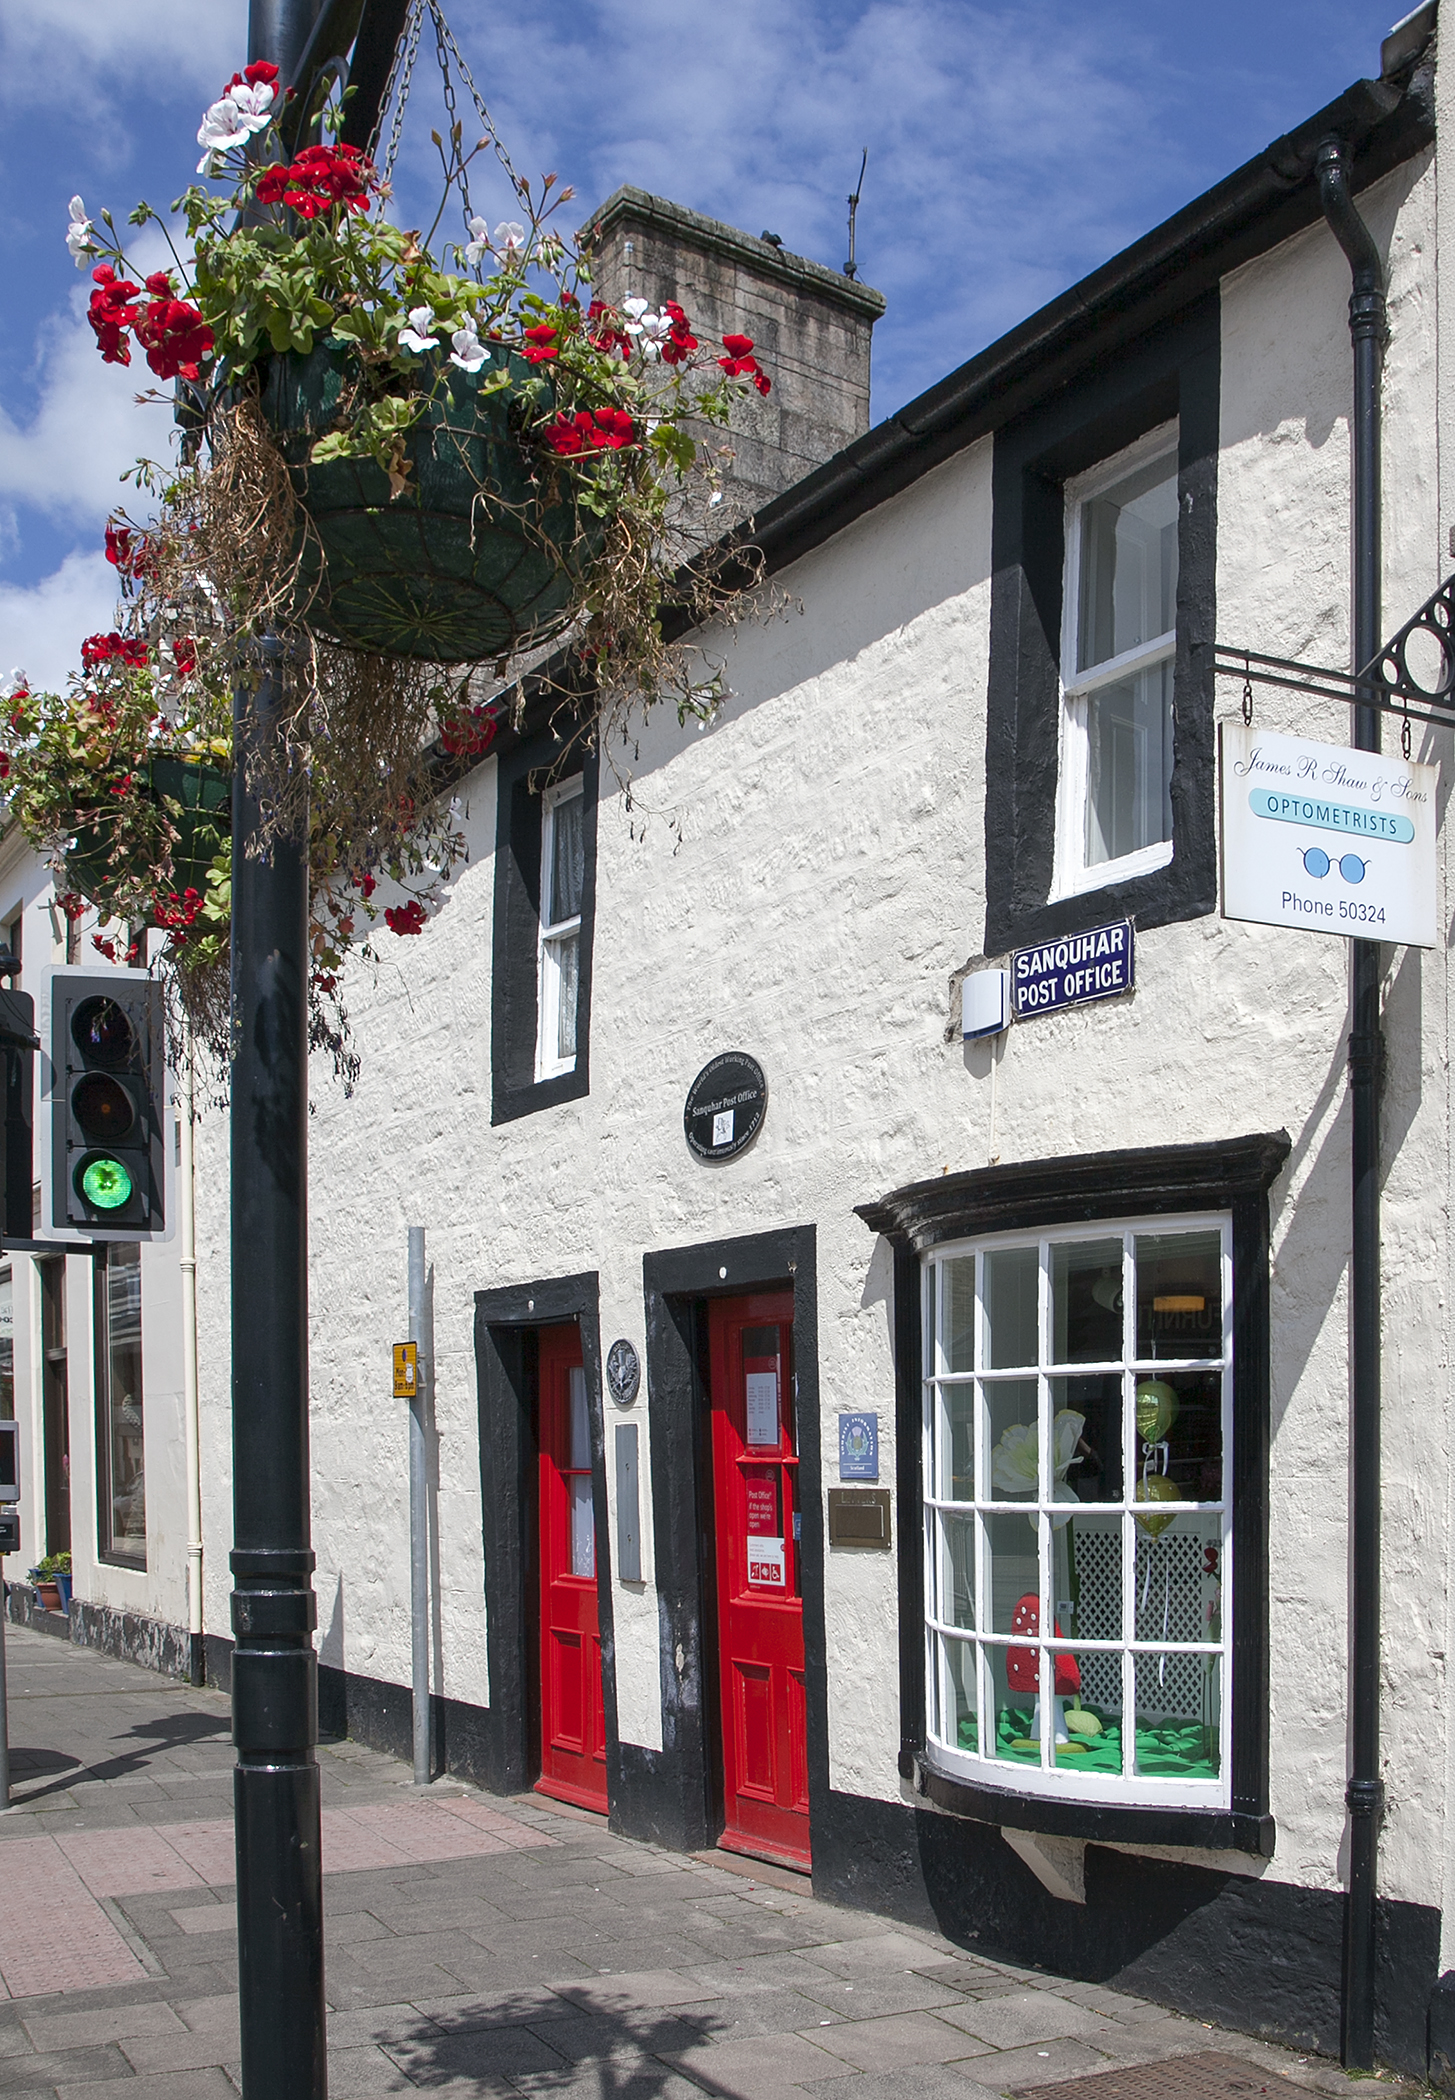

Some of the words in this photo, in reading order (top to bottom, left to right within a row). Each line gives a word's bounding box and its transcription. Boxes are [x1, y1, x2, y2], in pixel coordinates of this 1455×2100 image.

[1234, 748, 1292, 777] James
[1296, 755, 1318, 781] R
[1322, 762, 1368, 791] Shaw
[1370, 776, 1388, 802] &
[1390, 776, 1428, 803] Sons
[1267, 796, 1397, 835] OPTOMETRISTS
[1282, 891, 1334, 916] Phone
[1338, 900, 1386, 924] 50324
[1017, 928, 1124, 978] SANQUHAR
[1018, 978, 1058, 1010] POST
[1064, 960, 1122, 997] OFFICE
[692, 1101, 722, 1116] Sanquhar
[723, 1096, 737, 1108] Post
[737, 1090, 757, 1103] Office
[748, 1490, 757, 1499] Post
